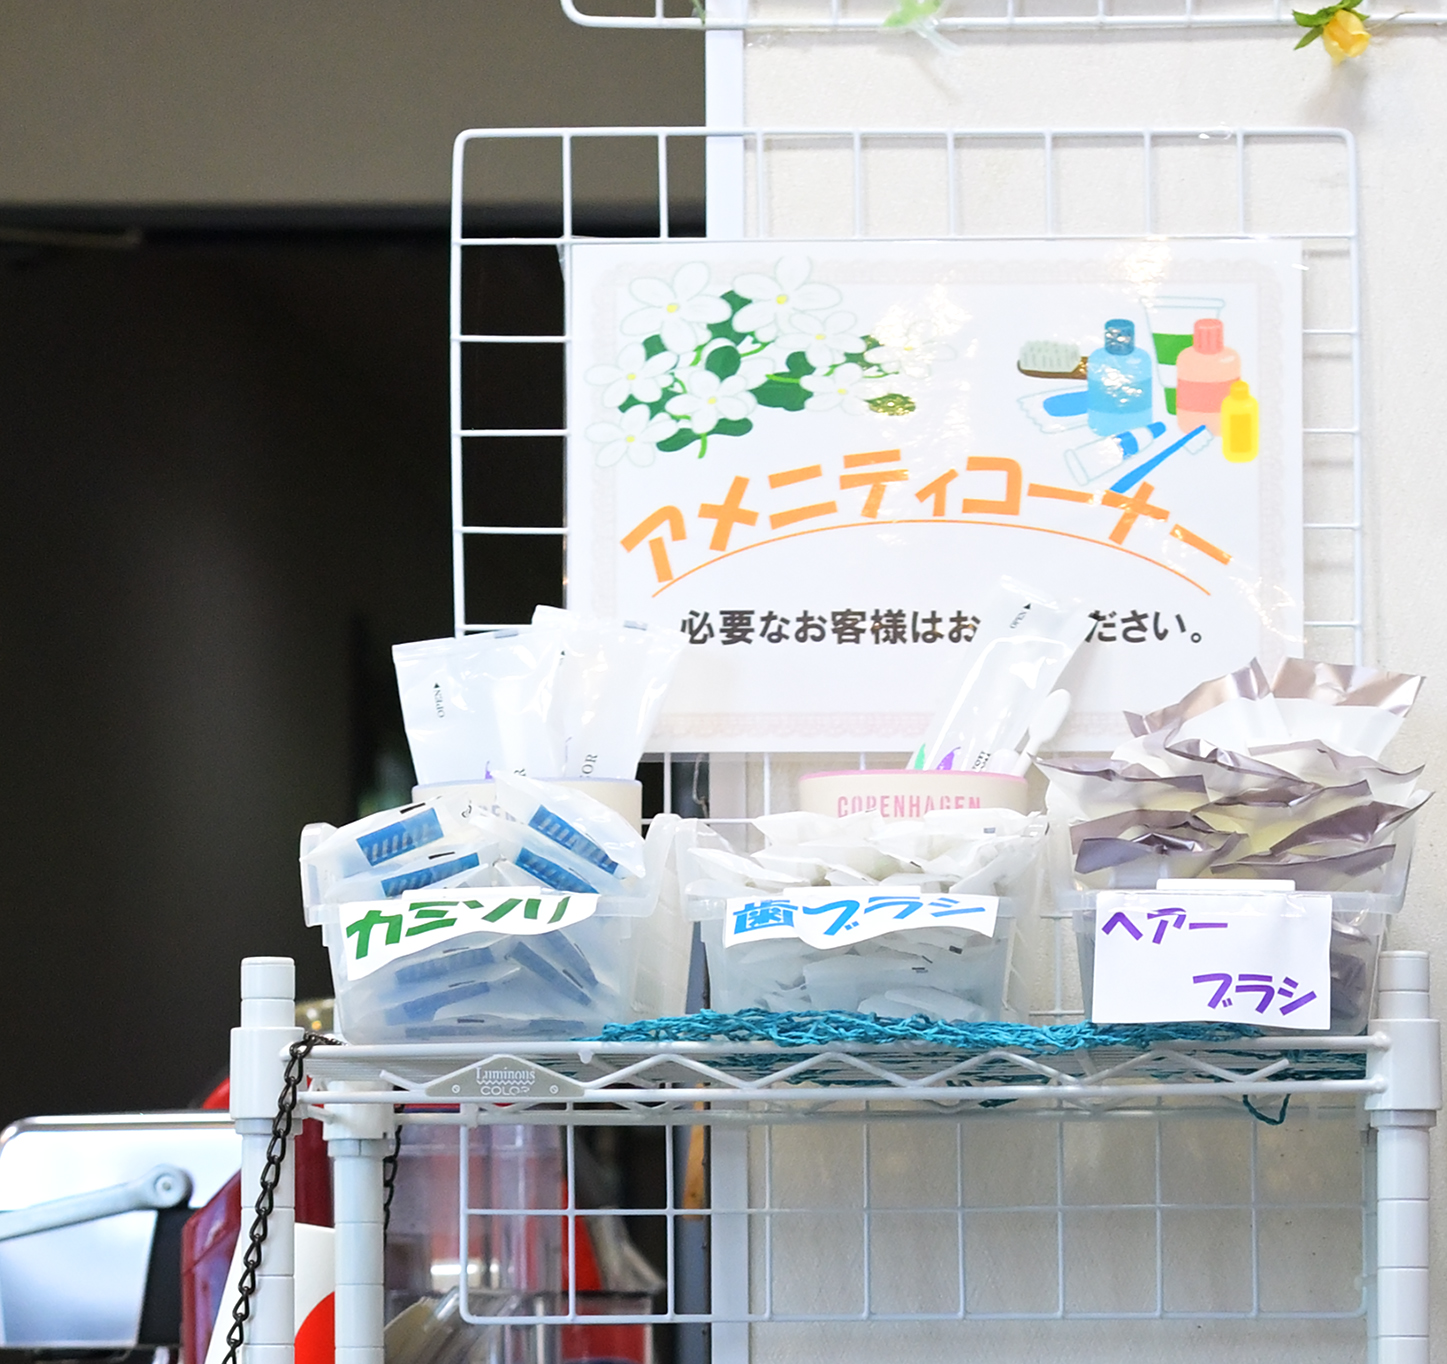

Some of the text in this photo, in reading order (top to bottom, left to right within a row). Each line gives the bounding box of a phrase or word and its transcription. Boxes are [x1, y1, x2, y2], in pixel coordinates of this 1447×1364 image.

[620, 448, 1231, 584] アメニティコーナー
[345, 896, 570, 960] カミソリ
[732, 895, 986, 937] 歯ブラシ
[1101, 906, 1229, 946] ヘアー
[1192, 972, 1318, 1017] ブラシ
[475, 1066, 537, 1081] Luminous
